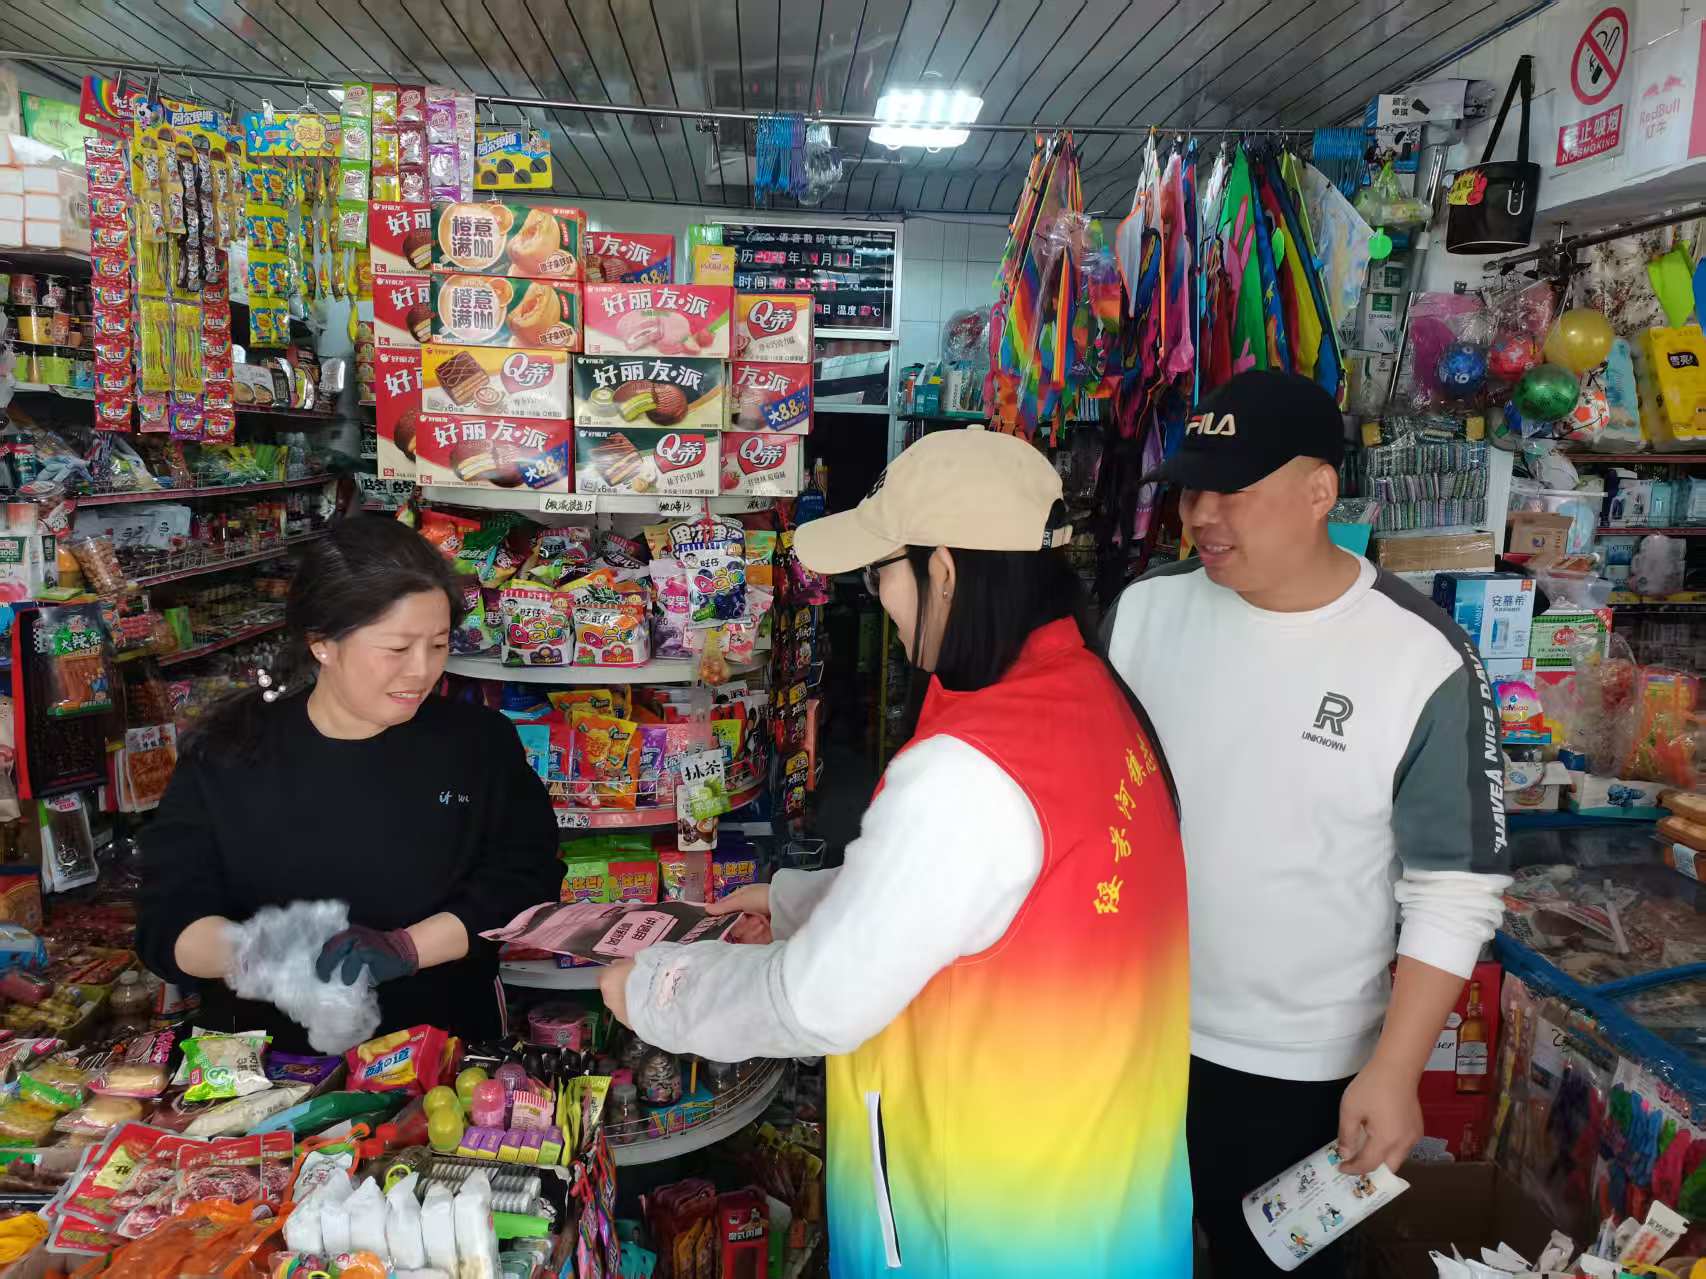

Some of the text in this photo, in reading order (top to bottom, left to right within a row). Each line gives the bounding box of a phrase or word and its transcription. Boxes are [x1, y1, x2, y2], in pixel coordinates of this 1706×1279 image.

[452, 215, 493, 237] 橙意
[452, 238, 493, 258] 满咖
[452, 288, 493, 309] 橙意
[452, 309, 493, 330] 满咖
[750, 300, 794, 332] Q蒂
[503, 352, 550, 386] Q蒂
[1185, 411, 1236, 436] FILA
[656, 433, 704, 465] Q蒂
[739, 437, 784, 465] Q蒂
[700, 558, 719, 567] 旺仔
[1492, 595, 1525, 608] 安慕希
[1301, 730, 1347, 752] UNKNOWN
[1483, 706, 1498, 762] NICE
[685, 760, 721, 781] 抹茶
